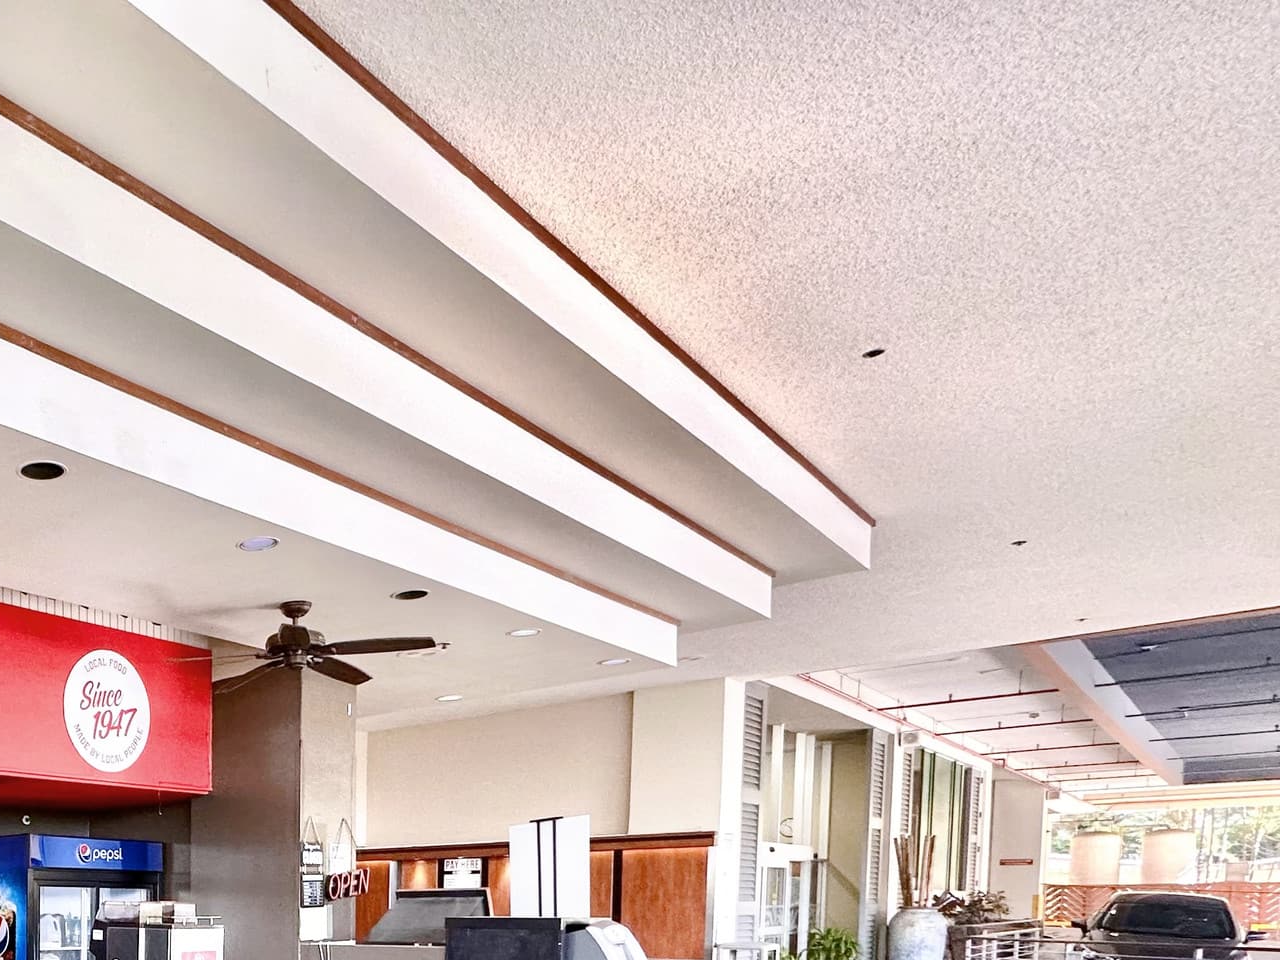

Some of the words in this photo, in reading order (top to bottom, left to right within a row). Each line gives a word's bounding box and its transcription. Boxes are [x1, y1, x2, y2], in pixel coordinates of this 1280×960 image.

[84, 657, 107, 673] LOCAL
[109, 658, 128, 675] FOOD
[80, 680, 122, 710] Since
[93, 708, 138, 740] 1947
[74, 723, 91, 751] MADE
[124, 727, 144, 759] PEOPLE
[92, 847, 123, 862] pepsi
[445, 860, 459, 869] PAY
[328, 866, 370, 900] OPEN
